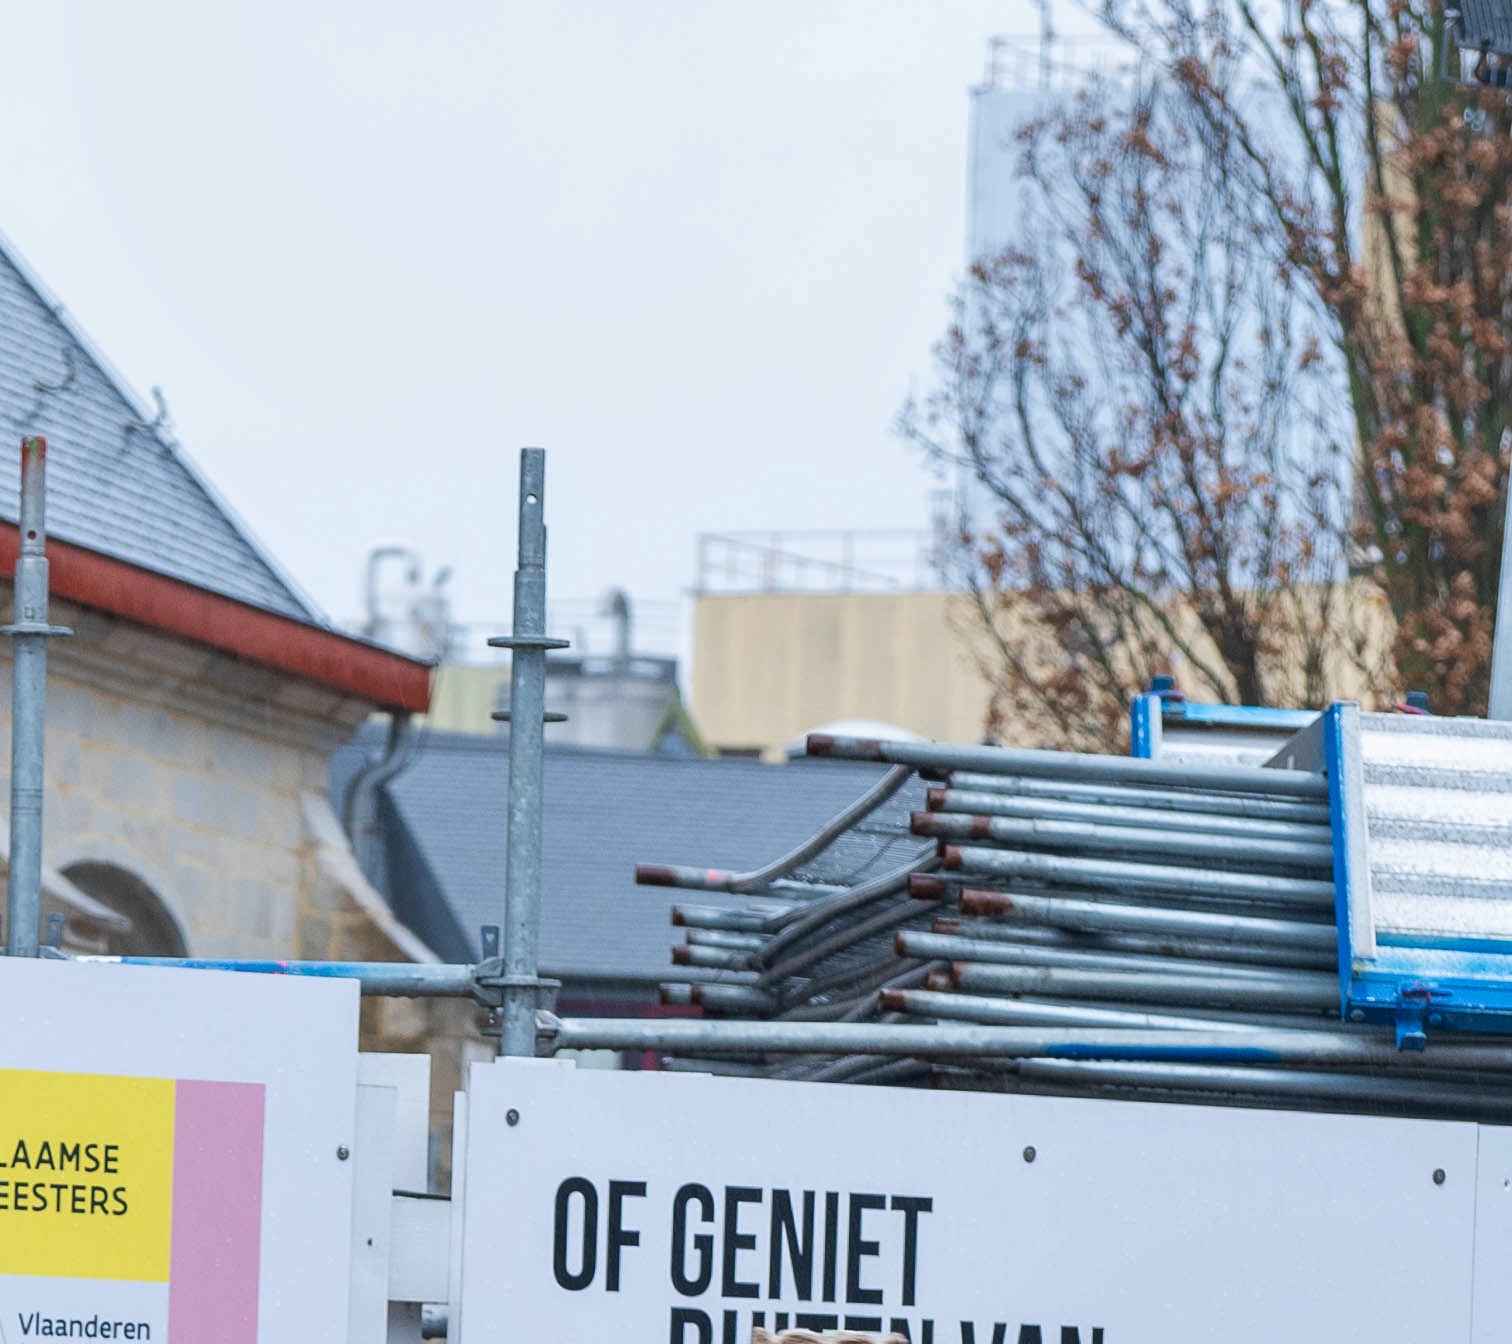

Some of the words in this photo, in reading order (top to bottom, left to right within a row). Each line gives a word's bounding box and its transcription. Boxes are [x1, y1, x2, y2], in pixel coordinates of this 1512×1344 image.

[553, 1177, 647, 1292] OF
[670, 1182, 933, 1306] GENIET
[18, 1312, 150, 1340] Vlaanderen
